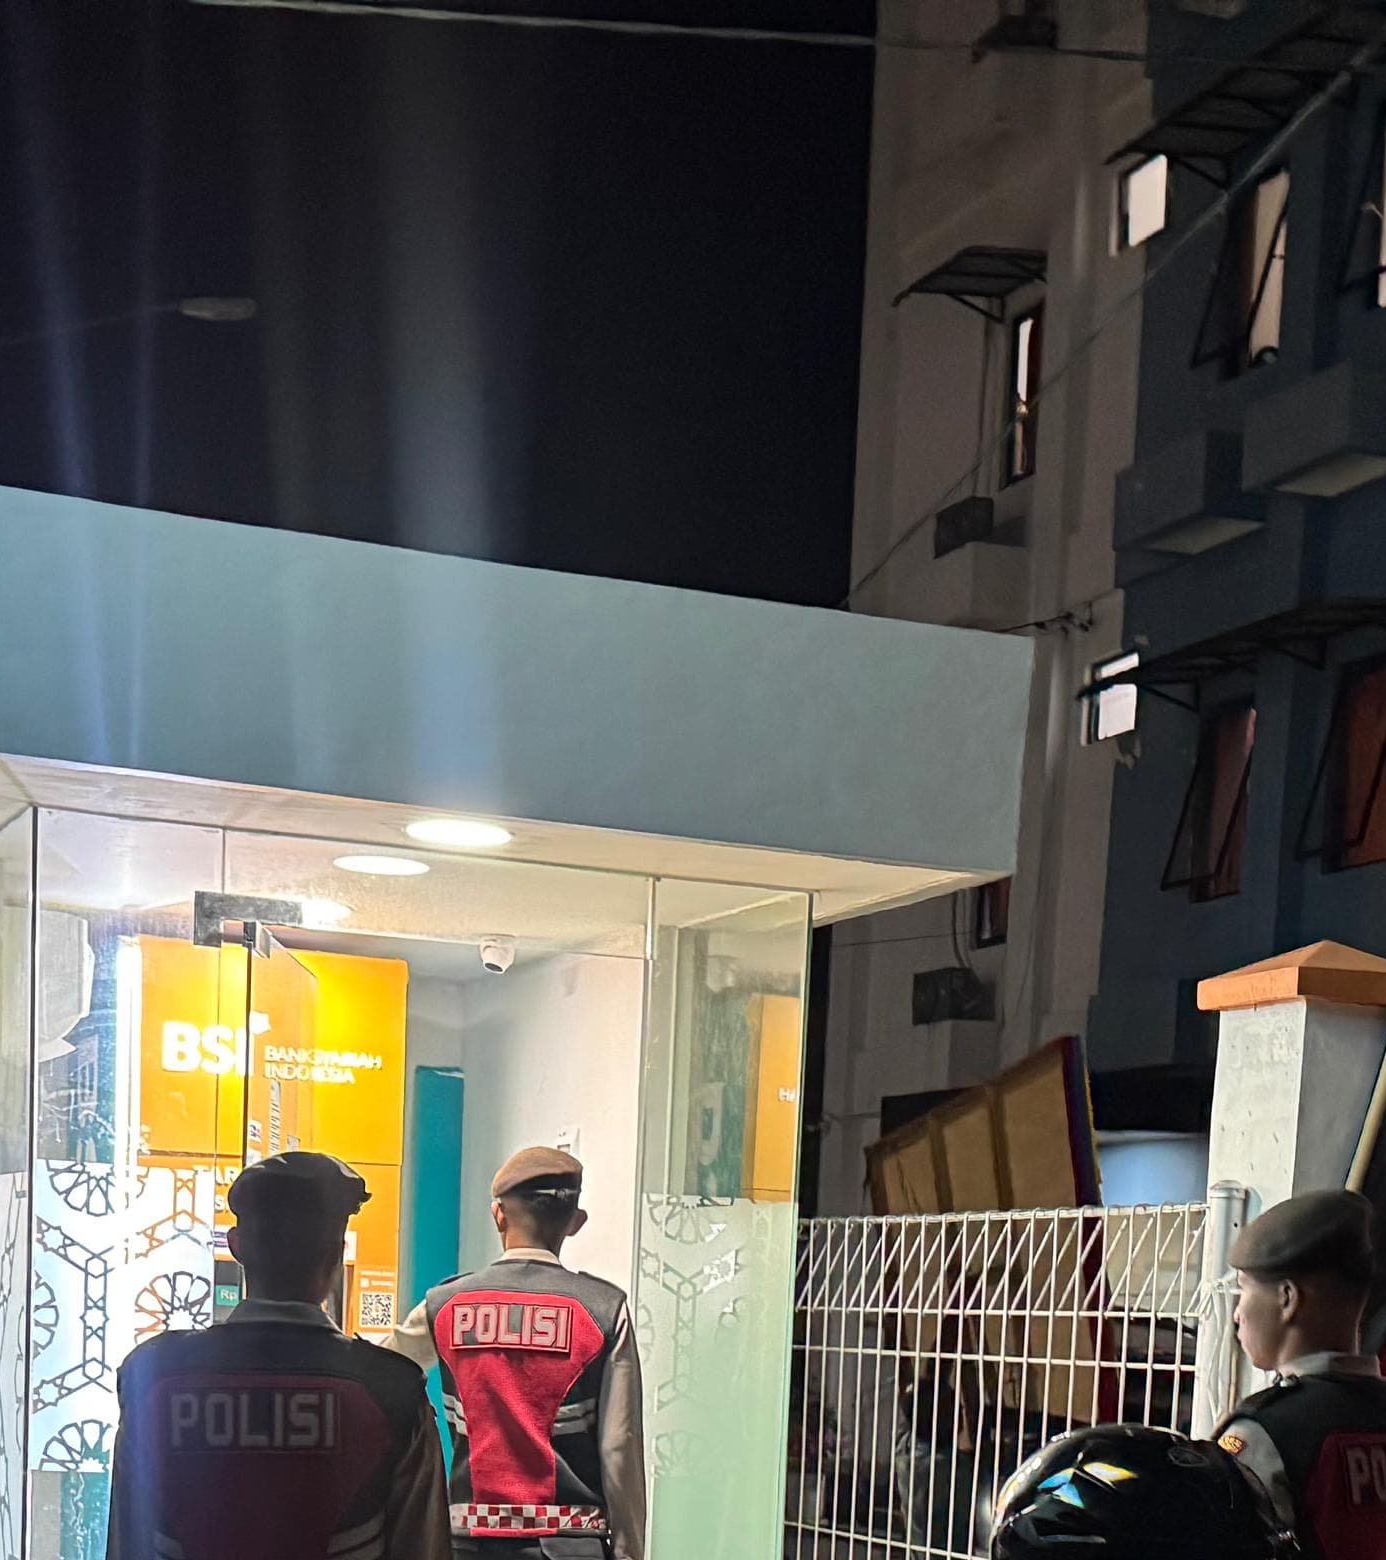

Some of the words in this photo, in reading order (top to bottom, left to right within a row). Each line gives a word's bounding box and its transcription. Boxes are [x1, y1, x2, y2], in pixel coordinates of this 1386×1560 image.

[162, 1021, 254, 1077] BSI
[220, 1289, 237, 1302] Rp
[453, 1303, 569, 1348] POLISI
[170, 1391, 335, 1449] POLISI
